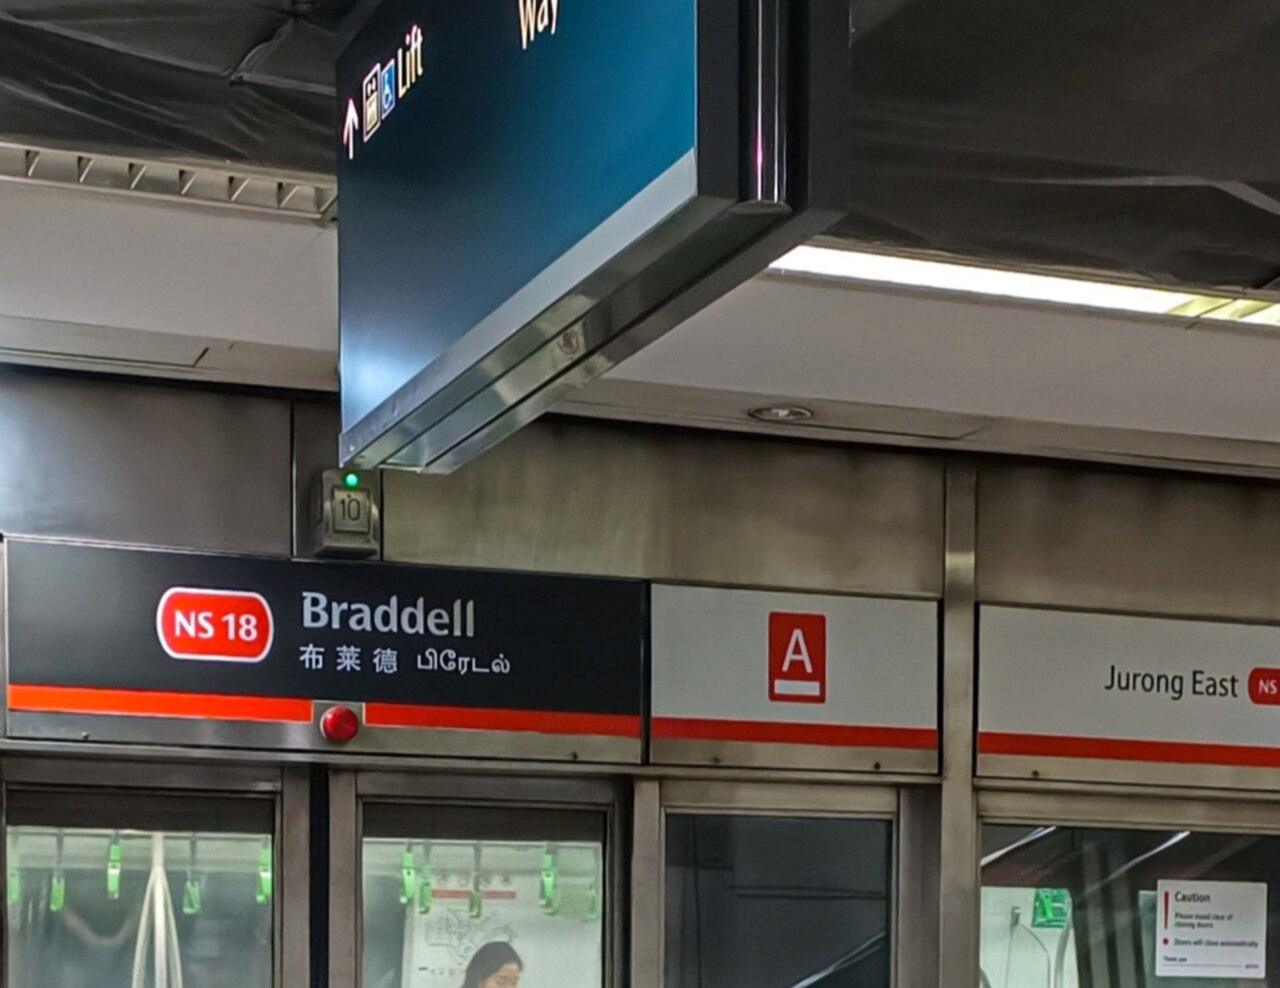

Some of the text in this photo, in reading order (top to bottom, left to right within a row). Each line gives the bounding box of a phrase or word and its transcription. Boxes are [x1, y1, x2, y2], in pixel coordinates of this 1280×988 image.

[397, 24, 423, 98] Lift
[340, 498, 361, 521] 10
[174, 610, 258, 641] NS 18
[301, 591, 475, 637] Braddell
[299, 643, 398, 673] 布莱德
[417, 647, 511, 675] பிரேடல்
[782, 628, 813, 674] A
[1104, 664, 1238, 701] Jurong East
[1258, 679, 1277, 695] NS
[1174, 891, 1211, 903] Caution
